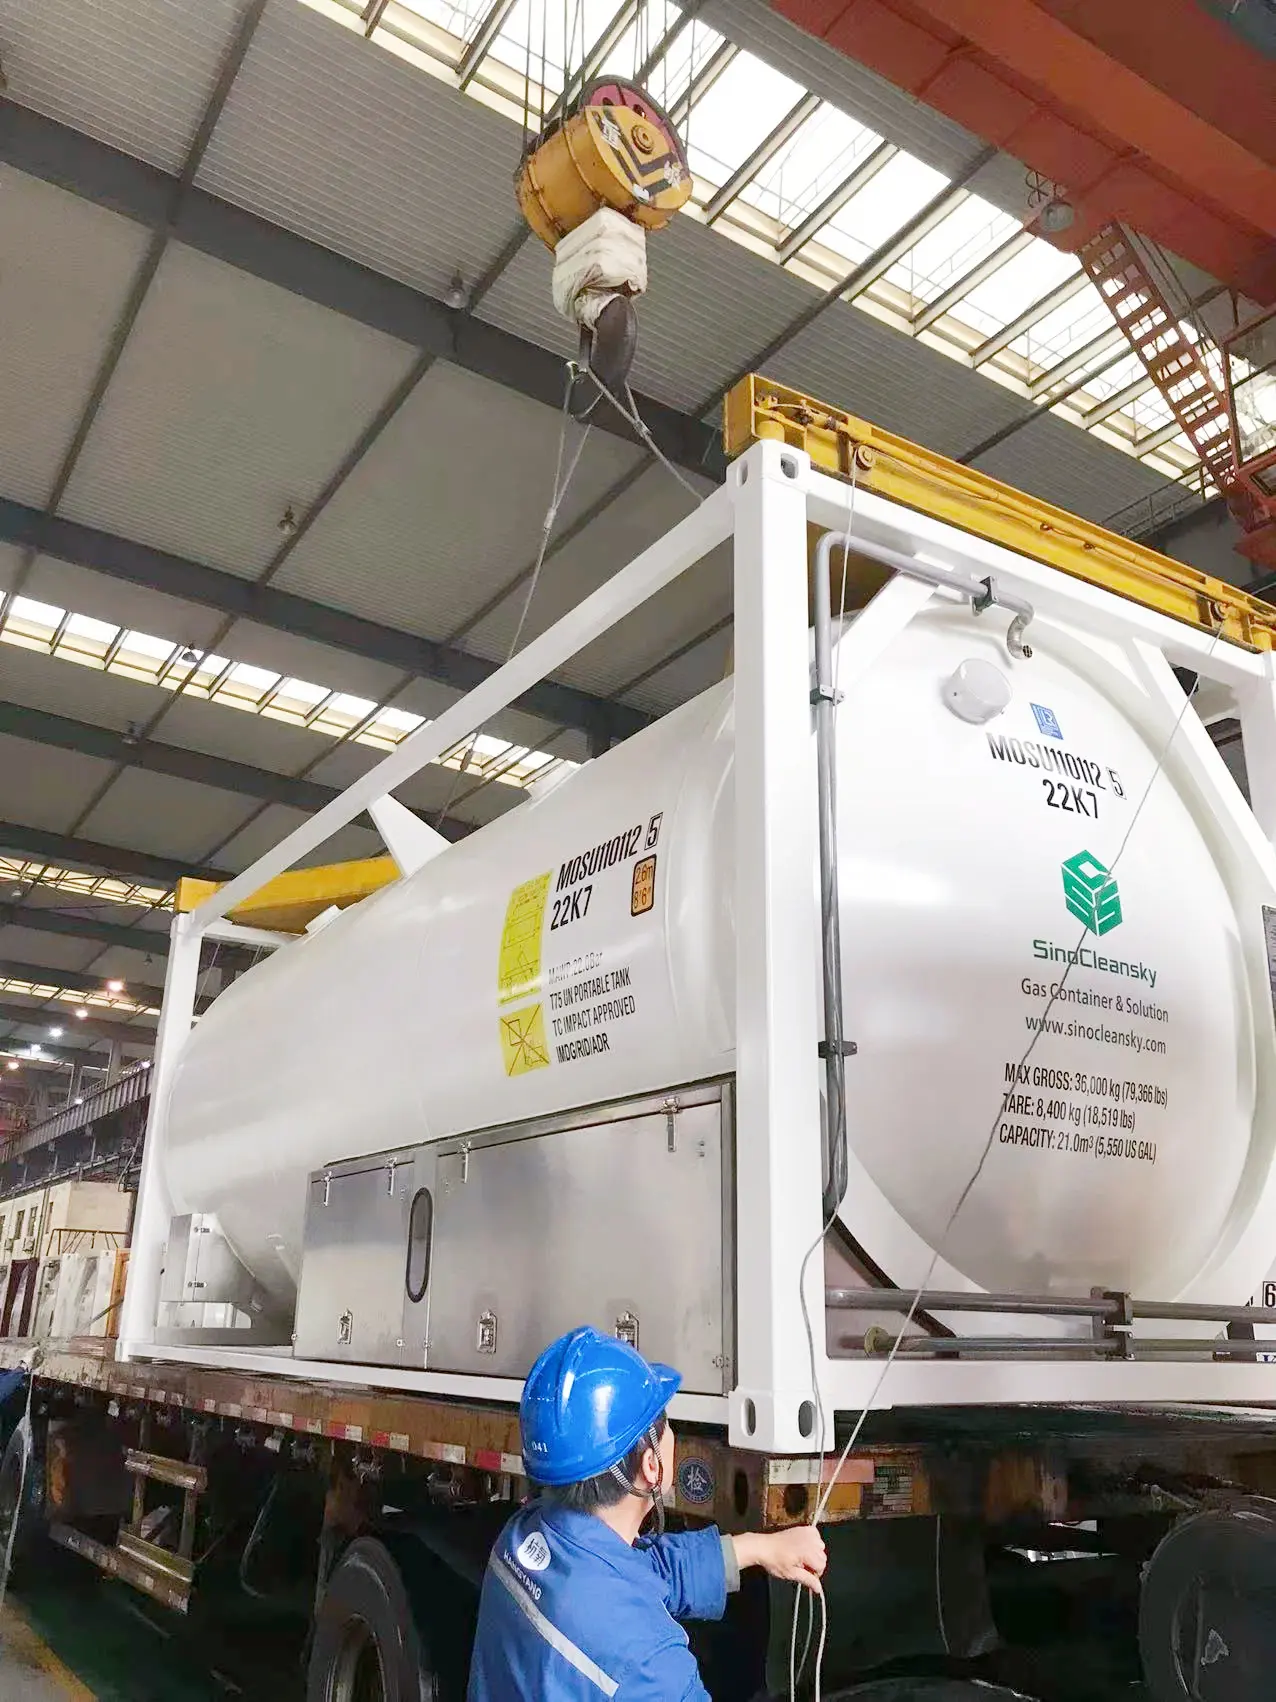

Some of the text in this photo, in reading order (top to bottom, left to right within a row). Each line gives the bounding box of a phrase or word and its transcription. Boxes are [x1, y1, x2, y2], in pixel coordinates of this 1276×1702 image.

[986, 732, 1124, 797] MOSU110112 5
[1042, 779, 1099, 819] 22K7
[556, 824, 643, 893] MOSU110112
[647, 815, 661, 847] 5
[550, 885, 593, 931] 22K7
[1032, 939, 1157, 988] SinoCleansky
[549, 991, 563, 1010] T75
[574, 974, 610, 1003] PORTABLE
[610, 966, 631, 990] TANK
[1021, 978, 1169, 1023] Gas Container & Solution
[552, 995, 636, 1037] TC IMPACT APPROVED
[1025, 1016, 1166, 1054] www.sinocleansky.com
[1004, 1063, 1168, 1110] MAX GROSS: 36,000 kg (79,366 lbs)
[1002, 1092, 1136, 1133] TARE: 8,400 kg (18,519 lbs)
[999, 1123, 1056, 1150] CAPACITY:
[1094, 1135, 1123, 1159] (5,550
[1124, 1139, 1137, 1159] US
[1138, 1140, 1156, 1165] GAL)
